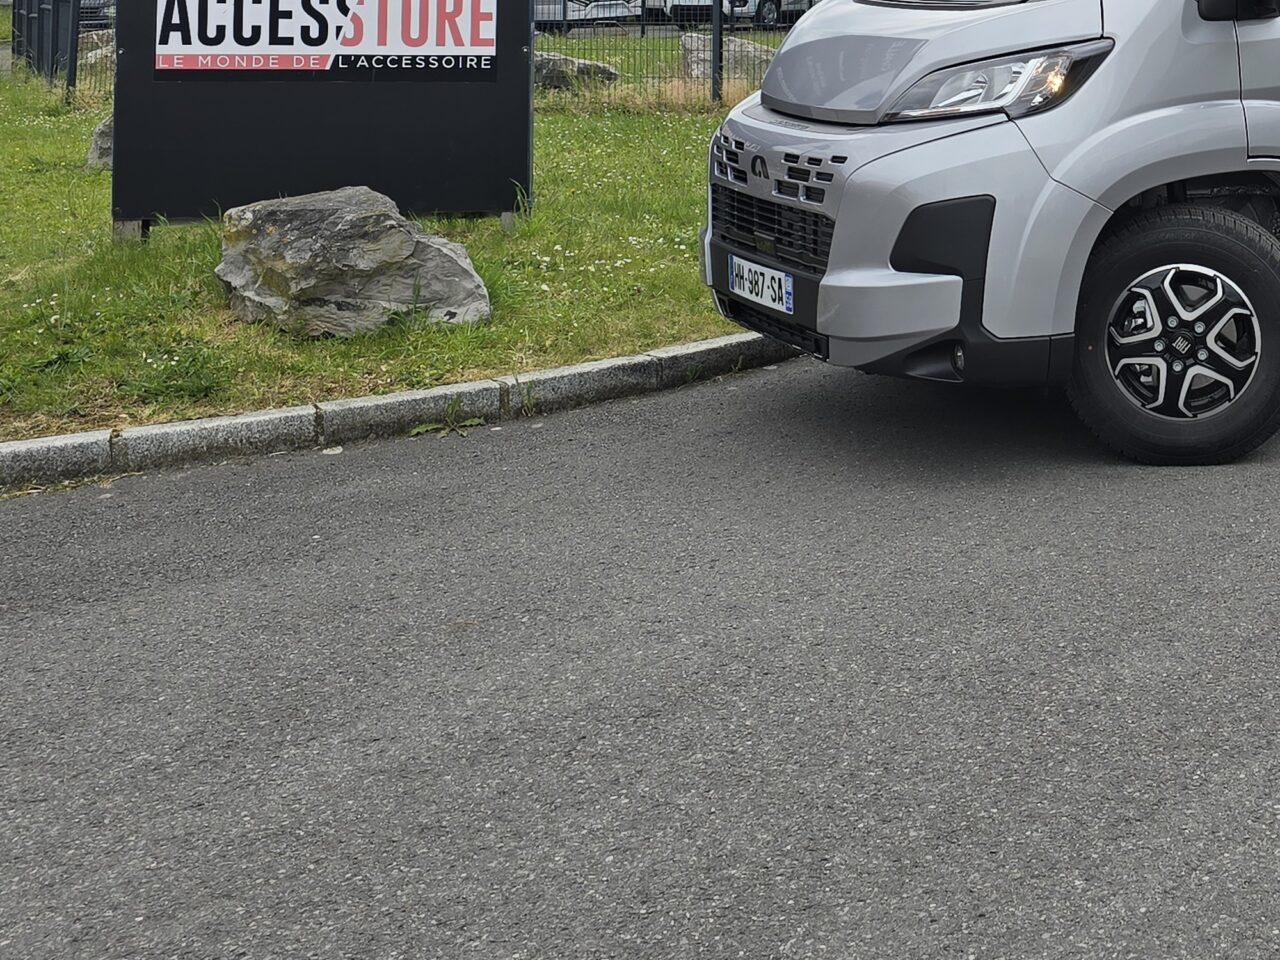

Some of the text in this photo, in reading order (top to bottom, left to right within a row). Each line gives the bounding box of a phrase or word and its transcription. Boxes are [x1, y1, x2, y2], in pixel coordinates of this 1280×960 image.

[159, 54, 492, 69] LE MONDE DE L'ACCESSOIRE
